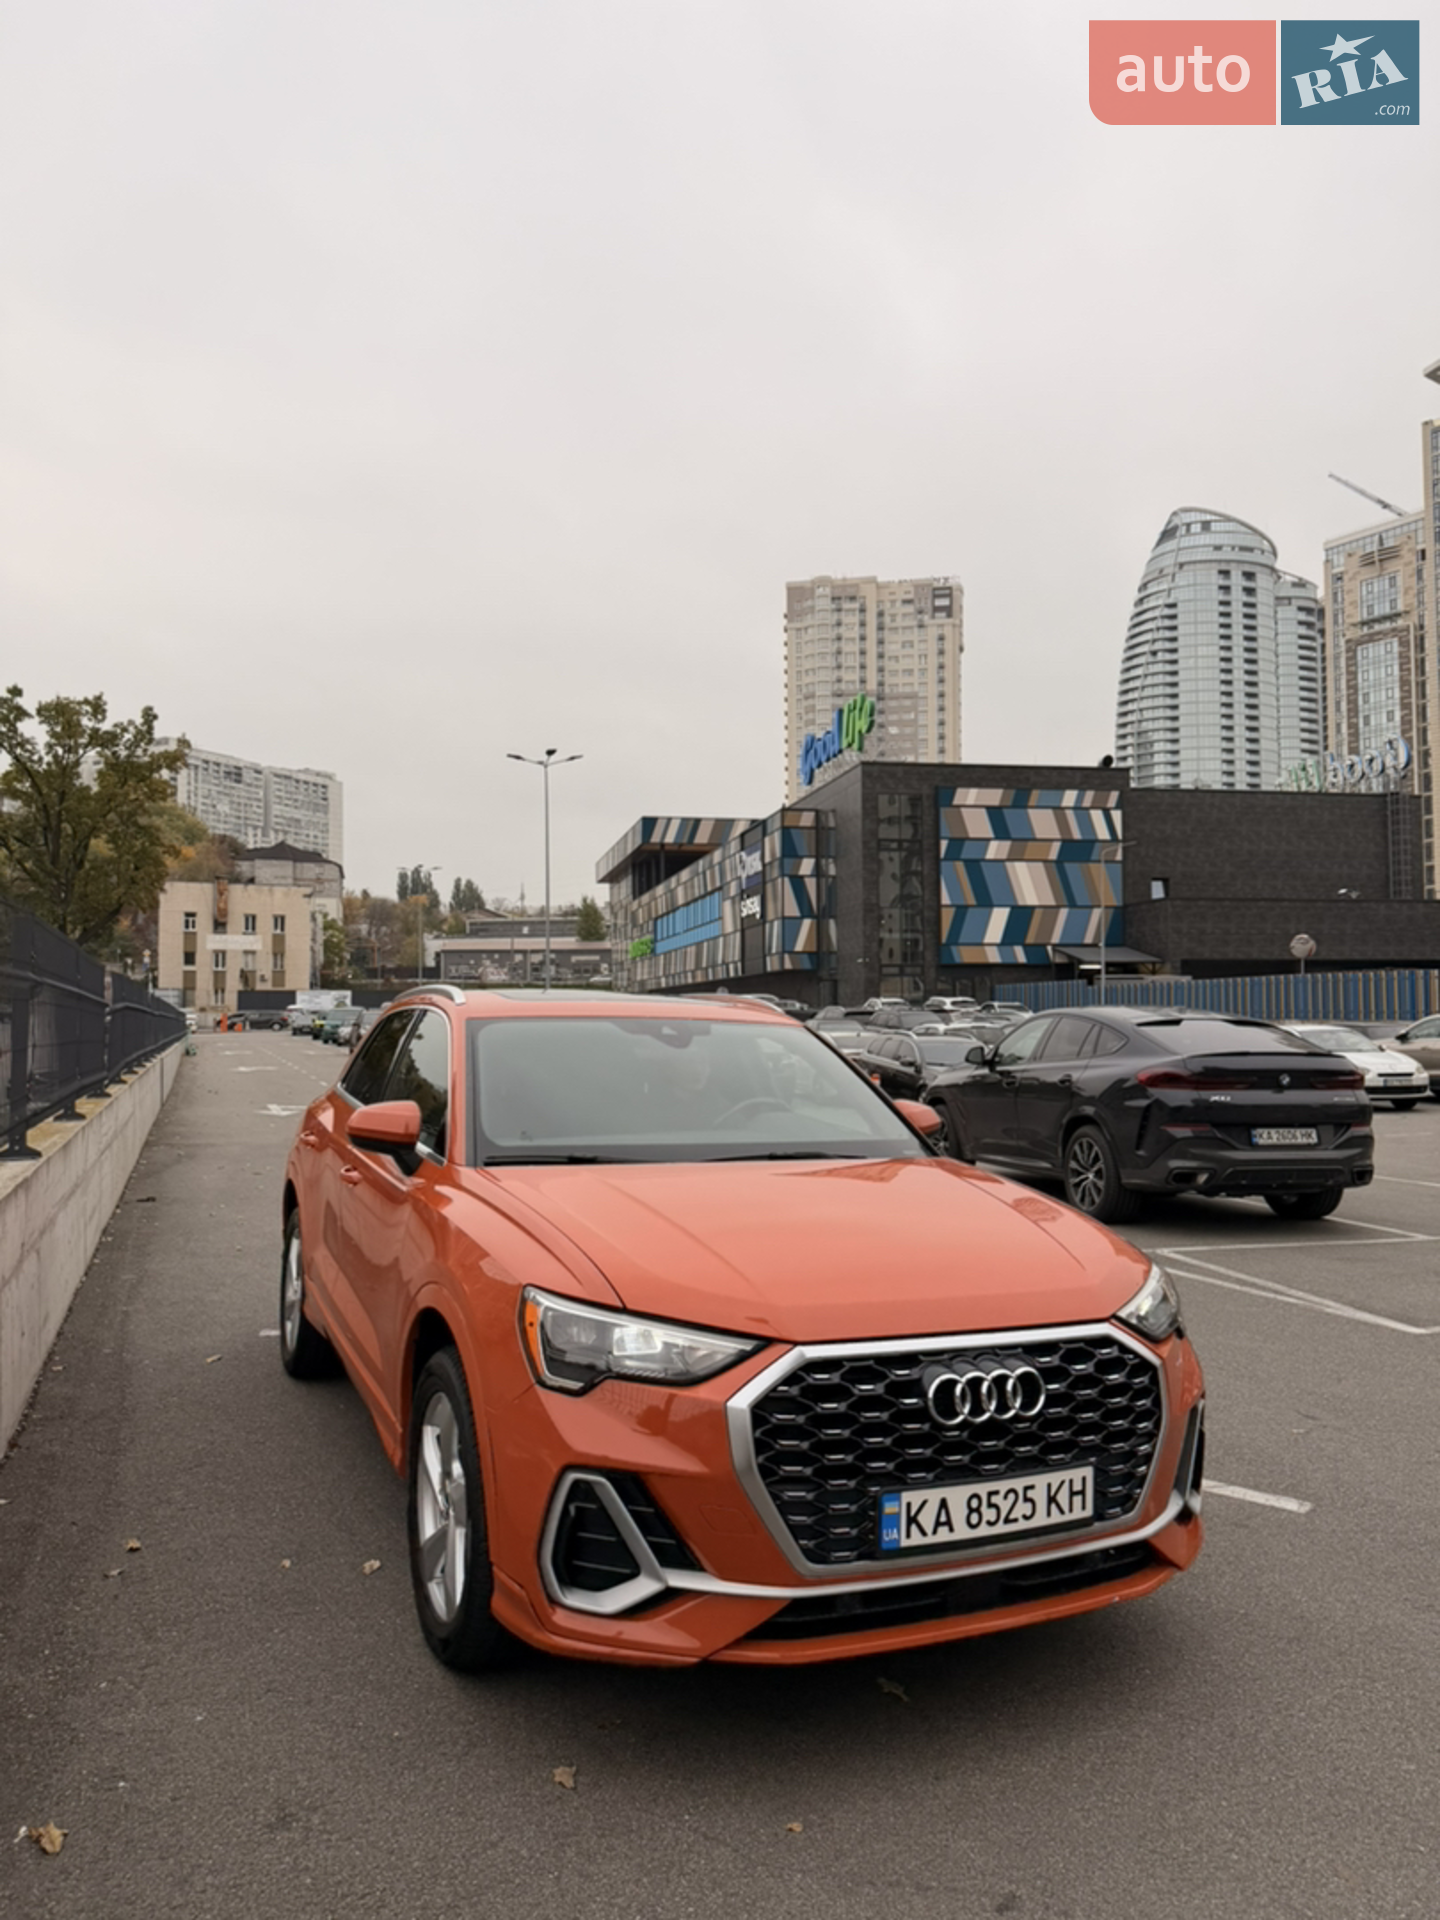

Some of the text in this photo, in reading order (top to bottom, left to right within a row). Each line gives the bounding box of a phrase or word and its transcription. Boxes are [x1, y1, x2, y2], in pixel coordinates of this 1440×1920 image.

[905, 1475, 1087, 1540] KA 8525 KH
[882, 1527, 899, 1541] UA
